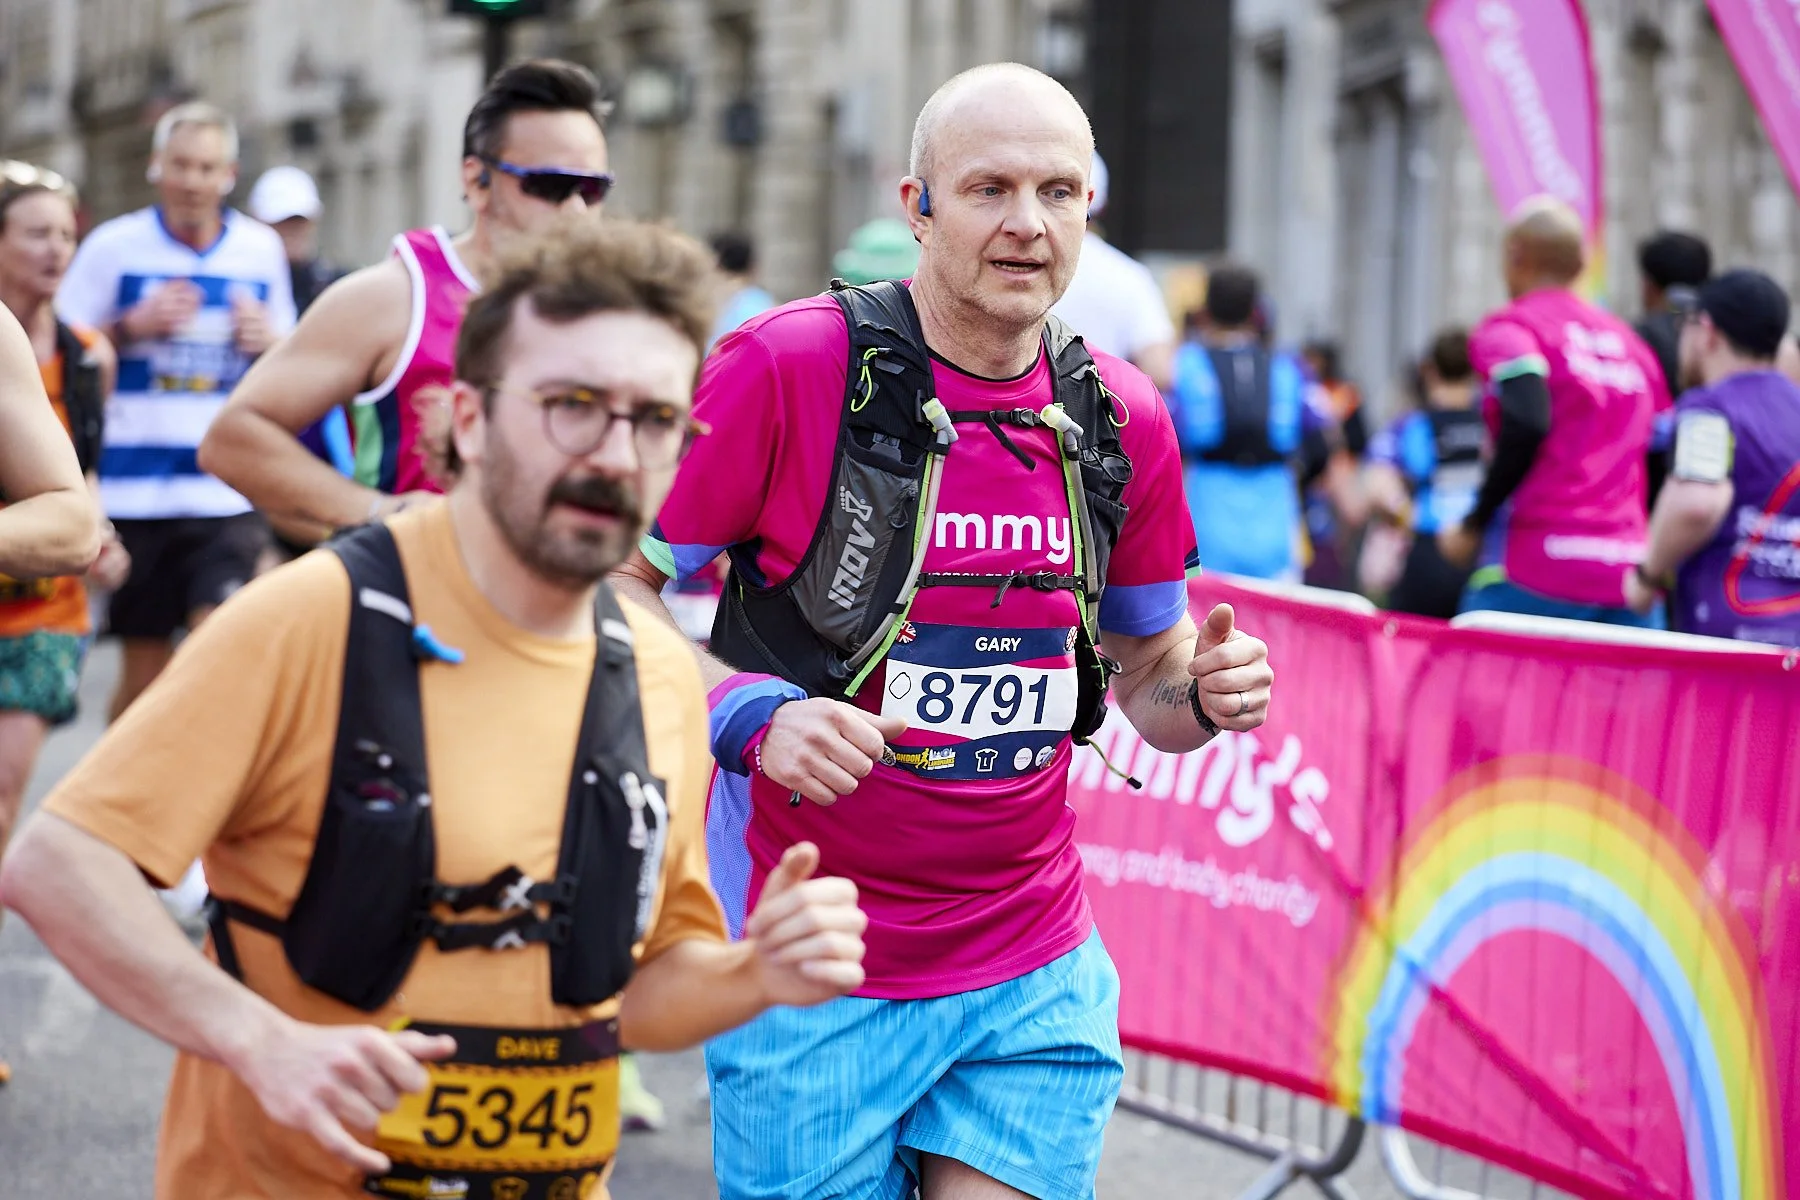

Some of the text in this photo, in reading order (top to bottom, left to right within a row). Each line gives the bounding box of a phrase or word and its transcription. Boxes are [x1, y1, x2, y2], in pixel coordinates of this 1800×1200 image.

[935, 512, 1071, 565] mmy
[975, 636, 1021, 652] GARY
[916, 671, 1049, 726] 8791
[896, 753, 921, 763] ONDON
[1066, 704, 1333, 850] mmy's
[496, 1035, 561, 1060] DAVE
[422, 1081, 595, 1150] 5345
